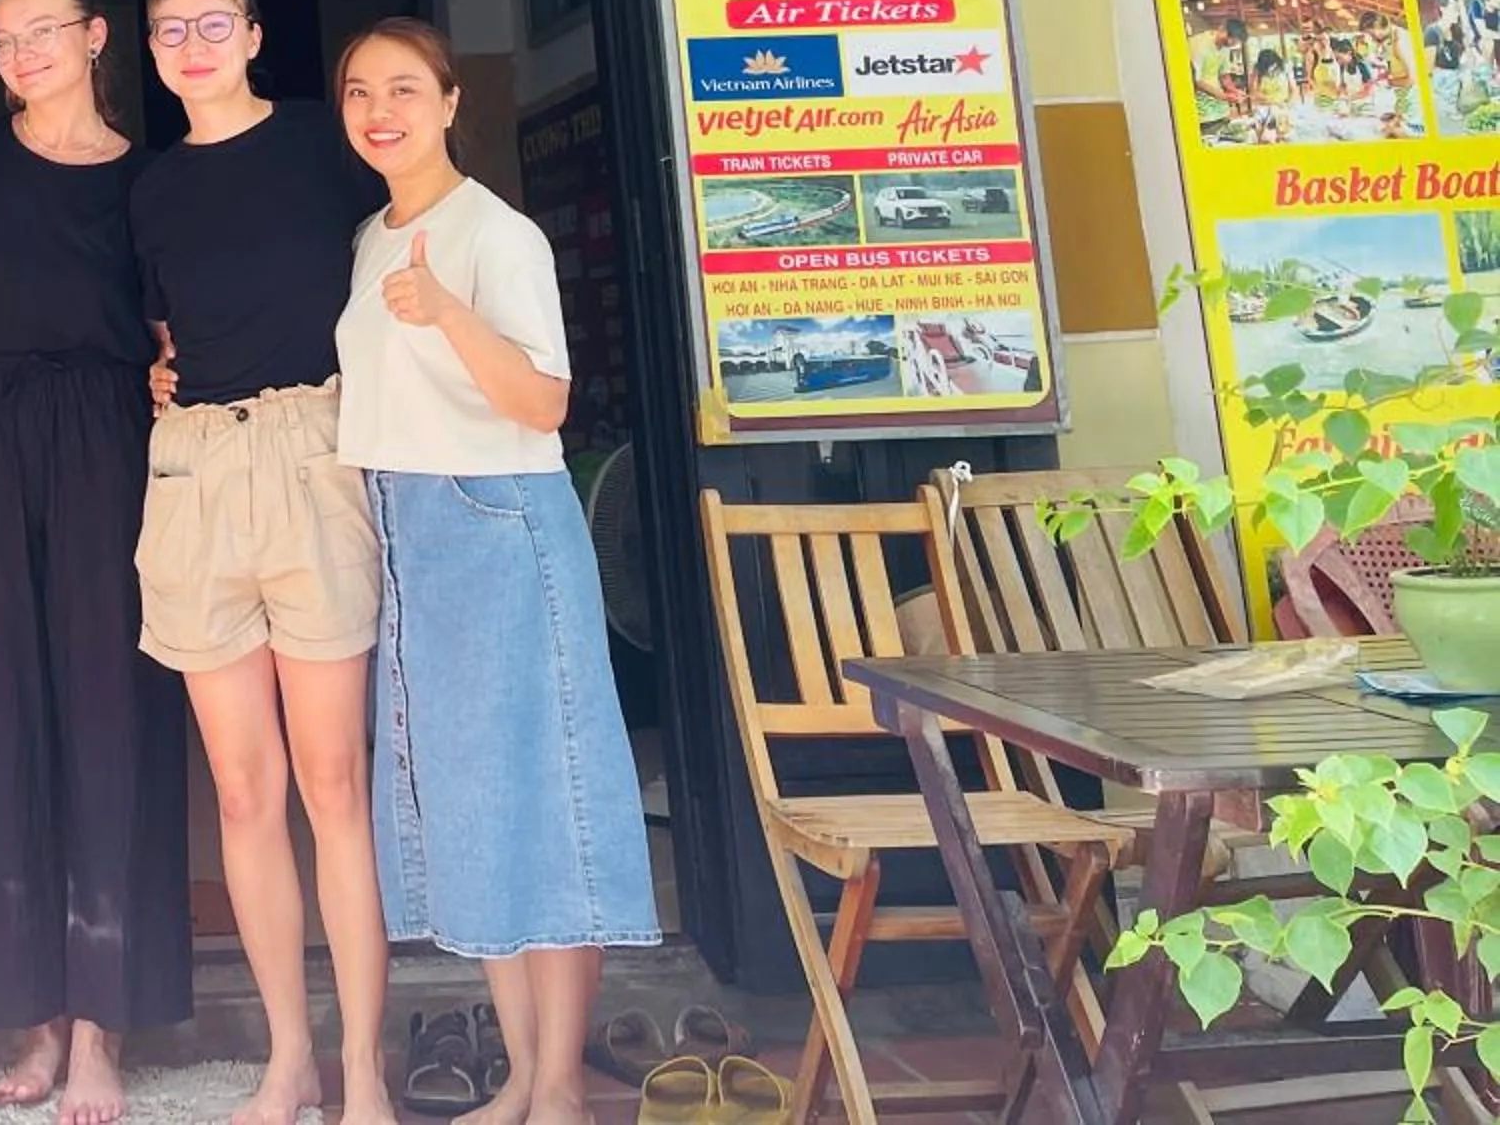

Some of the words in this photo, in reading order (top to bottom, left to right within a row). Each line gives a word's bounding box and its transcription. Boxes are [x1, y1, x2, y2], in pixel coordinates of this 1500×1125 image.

[745, 1, 804, 24] Air
[816, 0, 940, 23] Tickets
[855, 54, 955, 76] Jetstar
[700, 78, 771, 92] Vietnam
[772, 76, 835, 90] Airlines
[720, 157, 765, 171] TRAIN
[769, 154, 832, 169] TICKETS
[887, 151, 948, 165] PRIVATE
[952, 150, 983, 164] CAR
[1275, 166, 1406, 206] Basket
[778, 253, 839, 269] OPEN
[845, 251, 890, 267] BUS
[899, 248, 990, 265] TICKETS
[739, 281, 759, 293] AN
[769, 279, 798, 292] NHA
[801, 278, 848, 292] TRANG
[860, 276, 879, 288] DA
[881, 275, 905, 288] LAT
[1001, 270, 1029, 283] GON
[752, 303, 771, 315] AN
[783, 302, 803, 314] DA
[806, 300, 845, 313] NANG
[856, 299, 883, 311] HUE
[895, 297, 929, 310] NINH
[976, 295, 995, 308] HA
